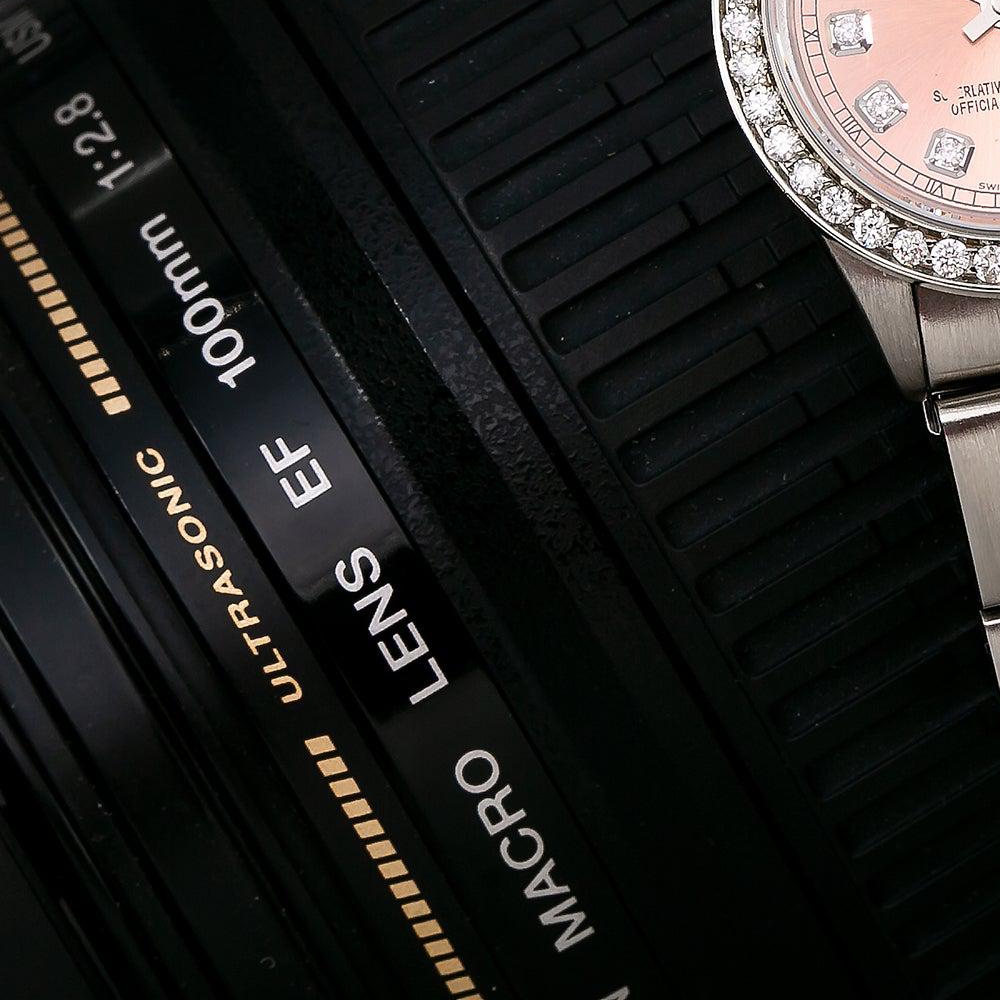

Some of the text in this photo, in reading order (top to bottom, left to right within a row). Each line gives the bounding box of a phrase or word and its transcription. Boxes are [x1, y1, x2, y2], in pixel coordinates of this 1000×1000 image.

[54, 92, 135, 191] 1:2.8
[139, 212, 256, 389] 100mm
[259, 437, 333, 509] EF
[135, 448, 303, 704] ULTRASONIC
[335, 547, 449, 705] LENS
[454, 749, 595, 953] MACRO
